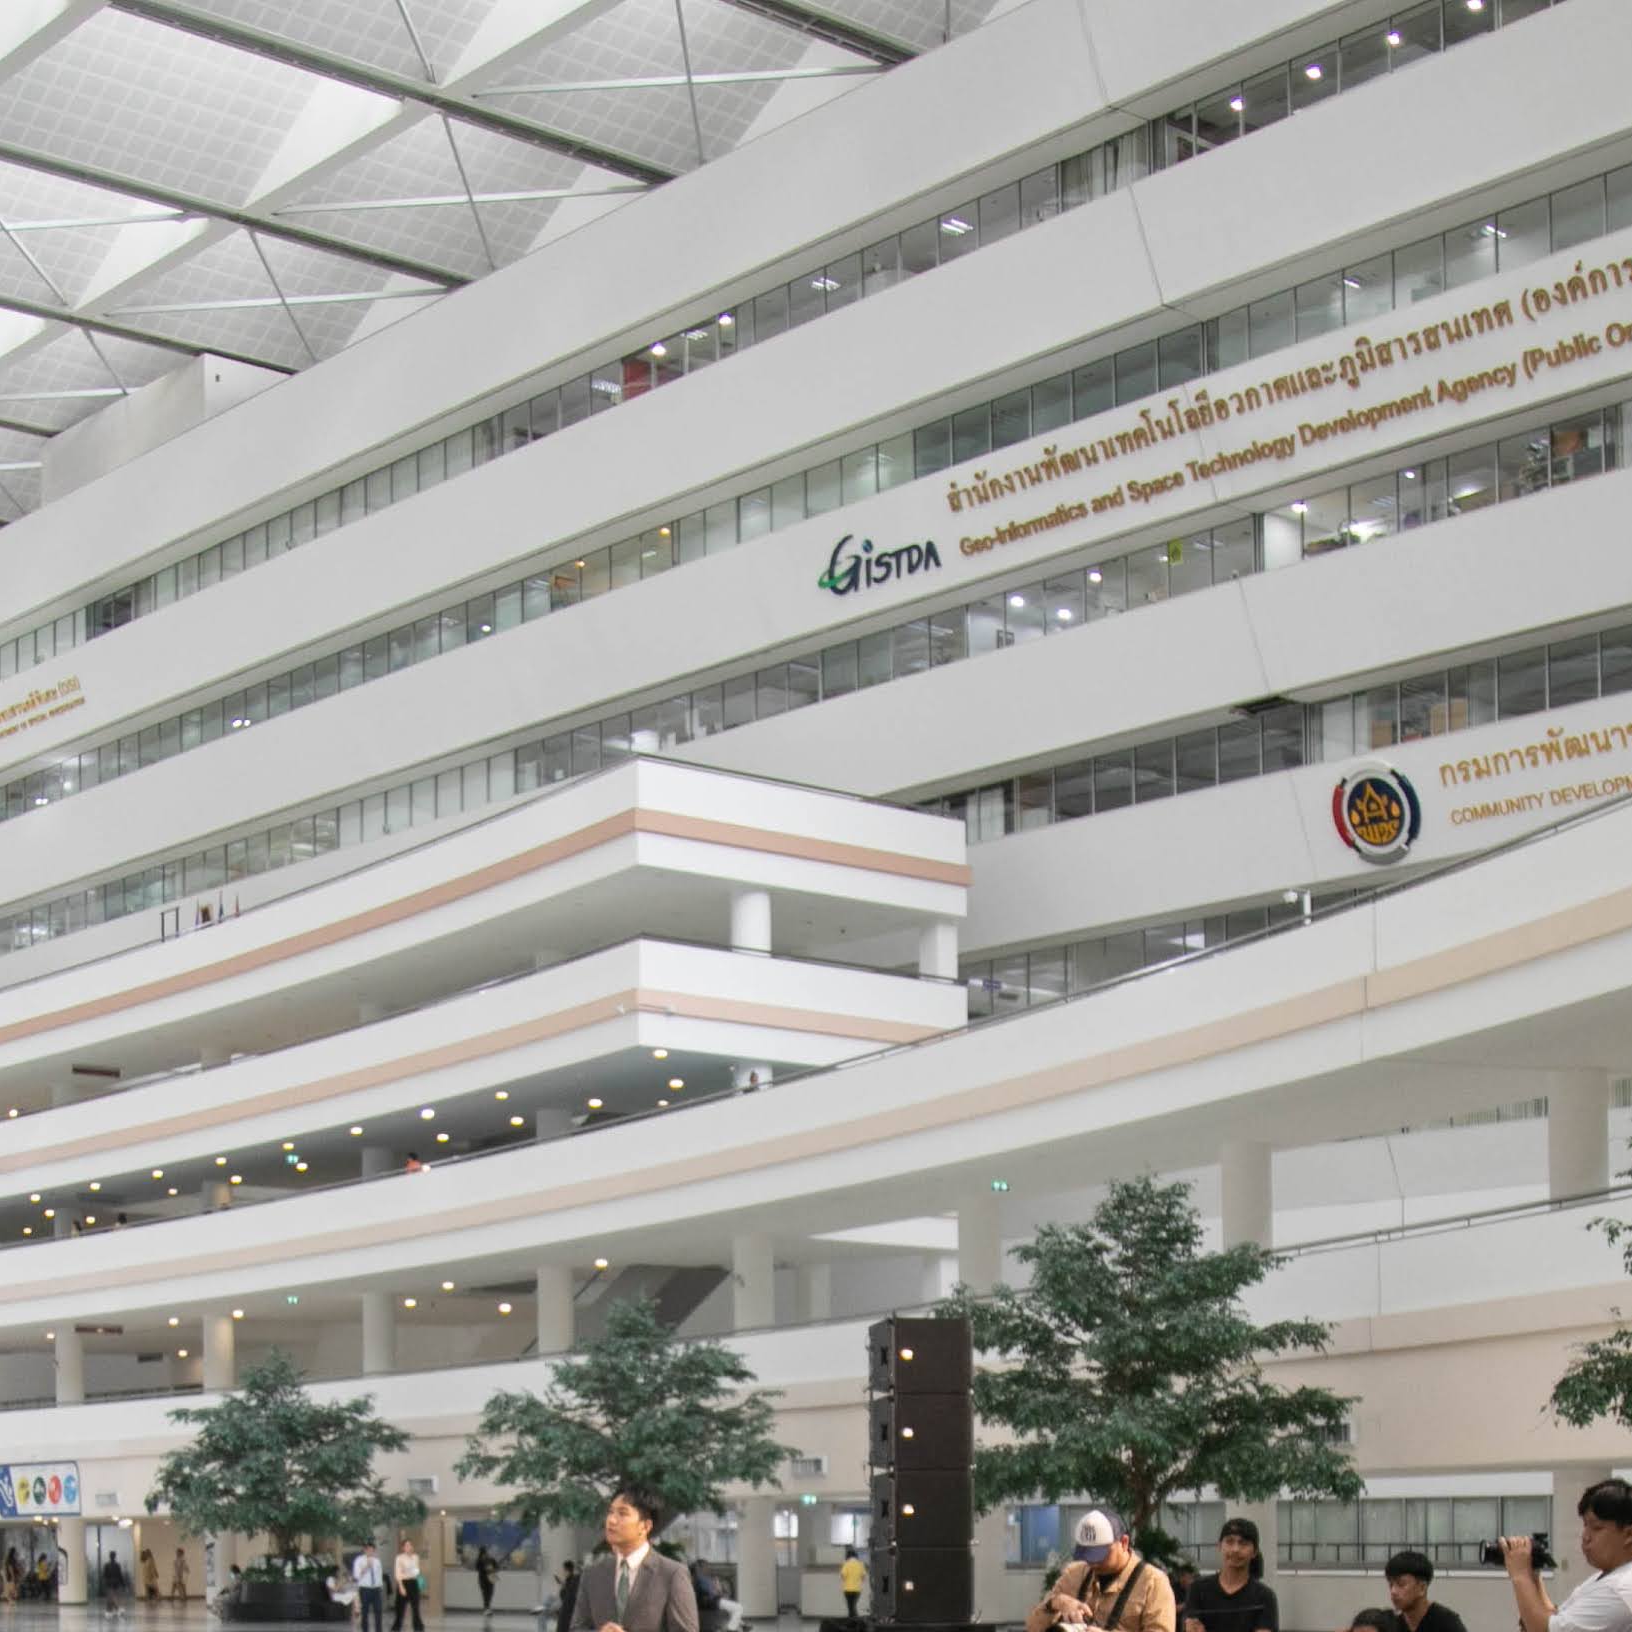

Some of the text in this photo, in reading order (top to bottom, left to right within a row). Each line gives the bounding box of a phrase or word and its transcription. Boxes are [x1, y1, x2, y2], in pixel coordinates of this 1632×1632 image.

[959, 503, 1089, 556] Geo-Informatics
[1092, 487, 1126, 514] and
[1126, 469, 1186, 504] Space
[1186, 433, 1297, 482] Technology
[1297, 385, 1434, 447] Development
[1436, 362, 1517, 404] Agency
[1522, 333, 1603, 379] (Public
[1450, 791, 1545, 826] COMMUNITY
